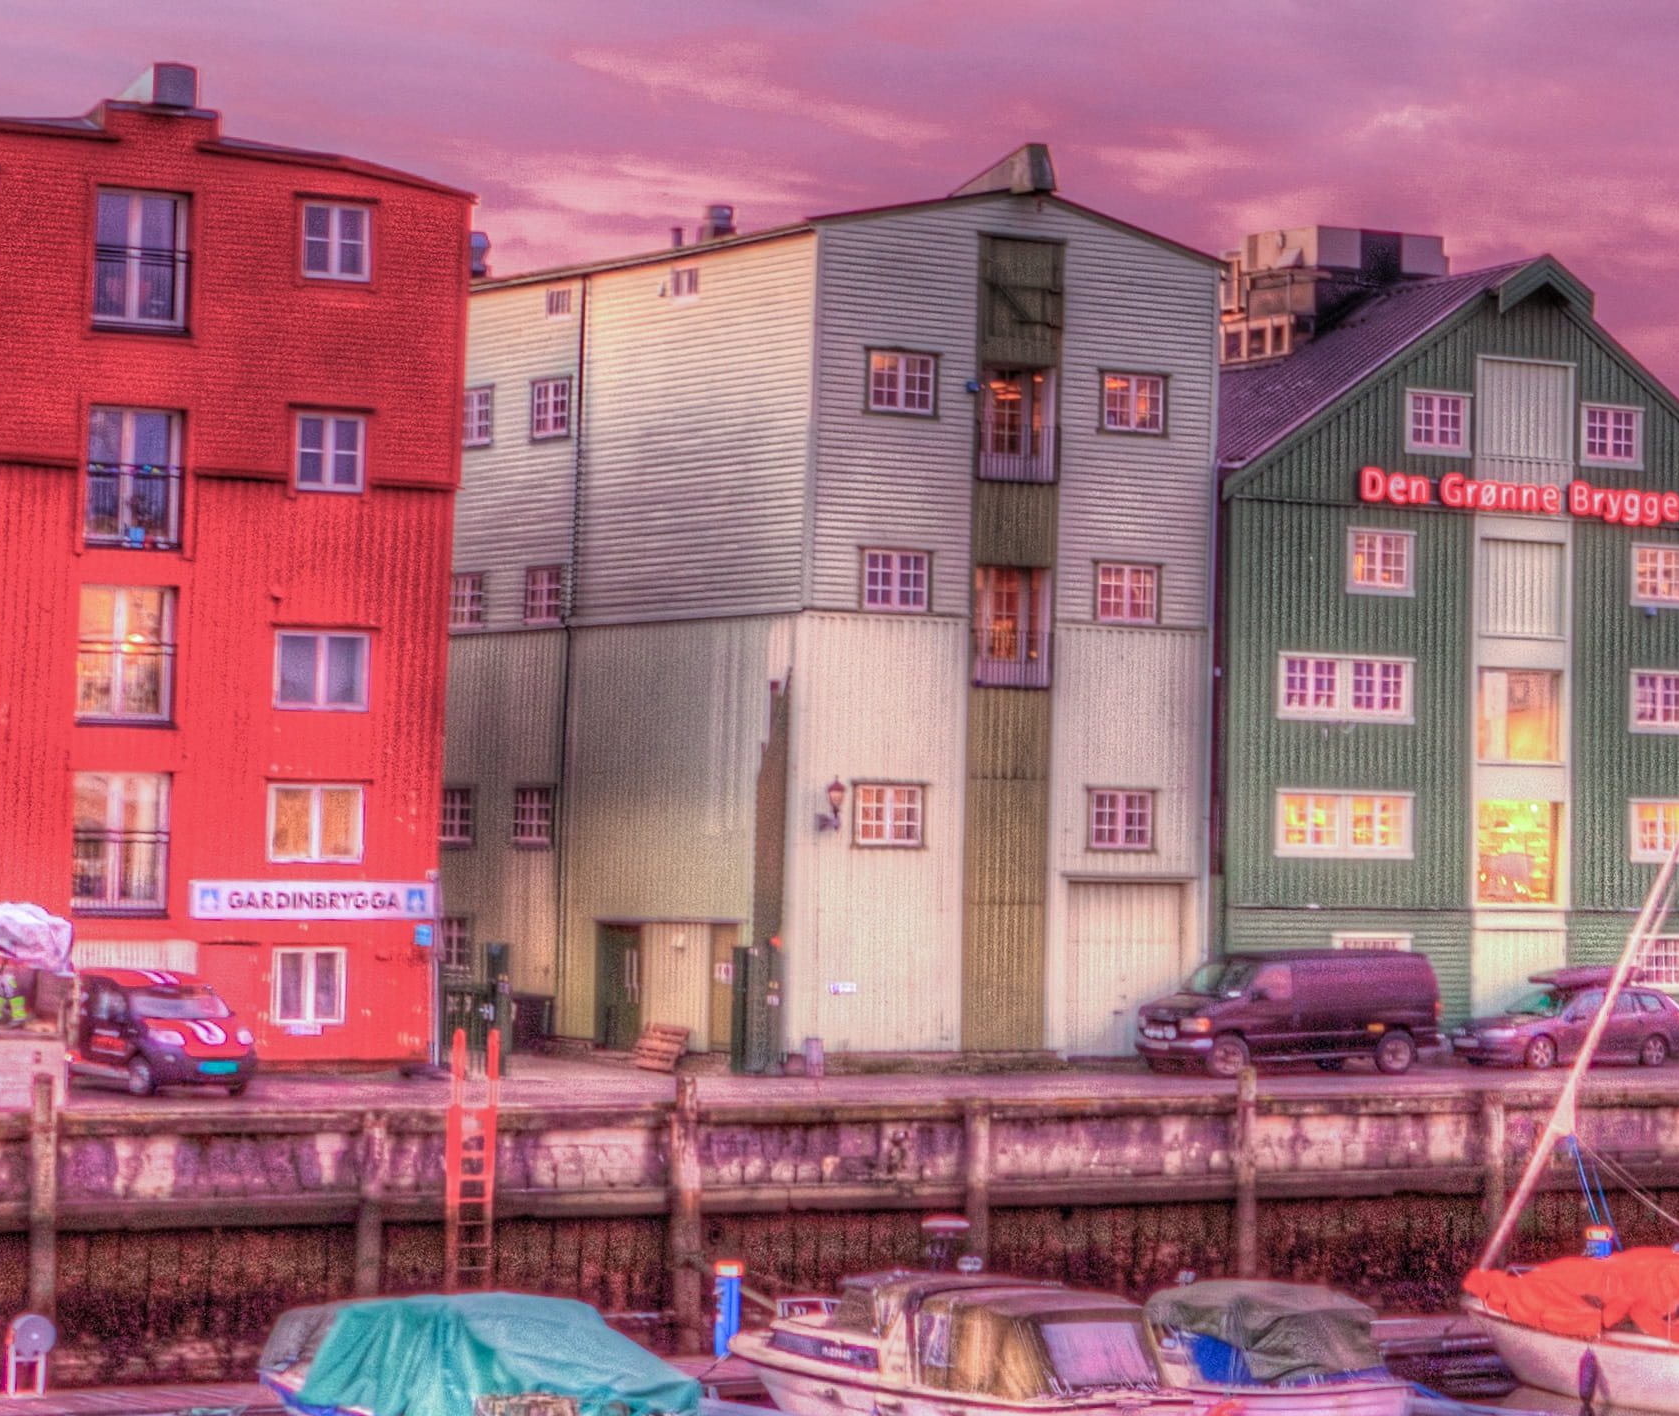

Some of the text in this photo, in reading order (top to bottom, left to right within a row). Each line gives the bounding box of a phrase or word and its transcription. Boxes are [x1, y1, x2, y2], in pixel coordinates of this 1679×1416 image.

[1360, 467, 1430, 505] Den
[1439, 472, 1562, 514] Grønne
[227, 891, 402, 911] GARDINBRYGGA
